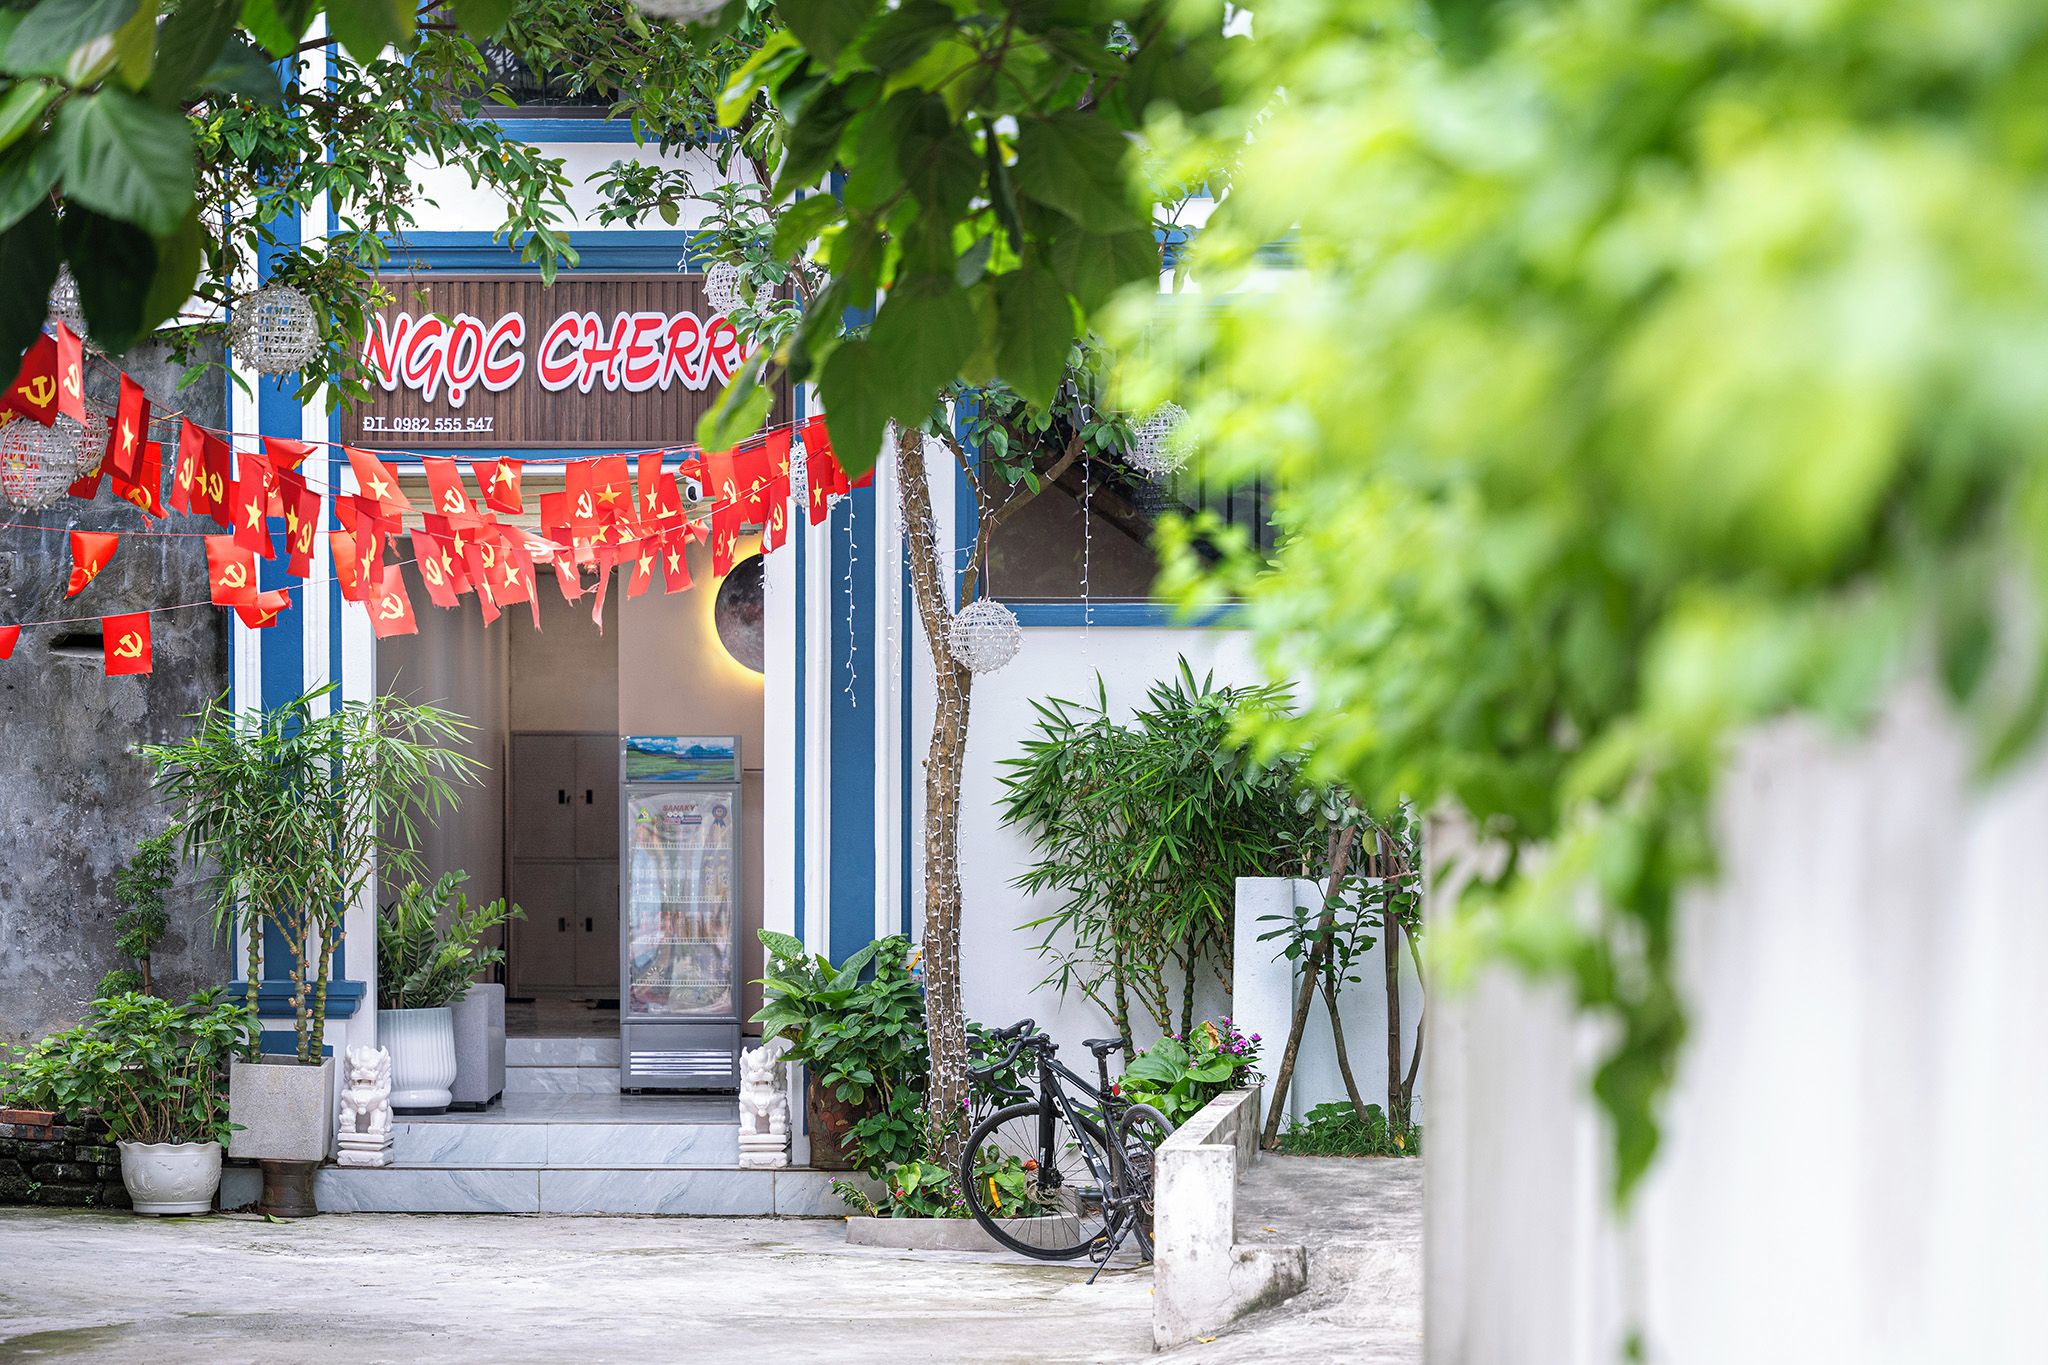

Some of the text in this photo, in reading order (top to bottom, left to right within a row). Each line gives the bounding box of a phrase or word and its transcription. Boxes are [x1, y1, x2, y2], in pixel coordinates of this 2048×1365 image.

[359, 311, 526, 409] NGỌC
[363, 416, 494, 431] ĐT. 0982 555 547
